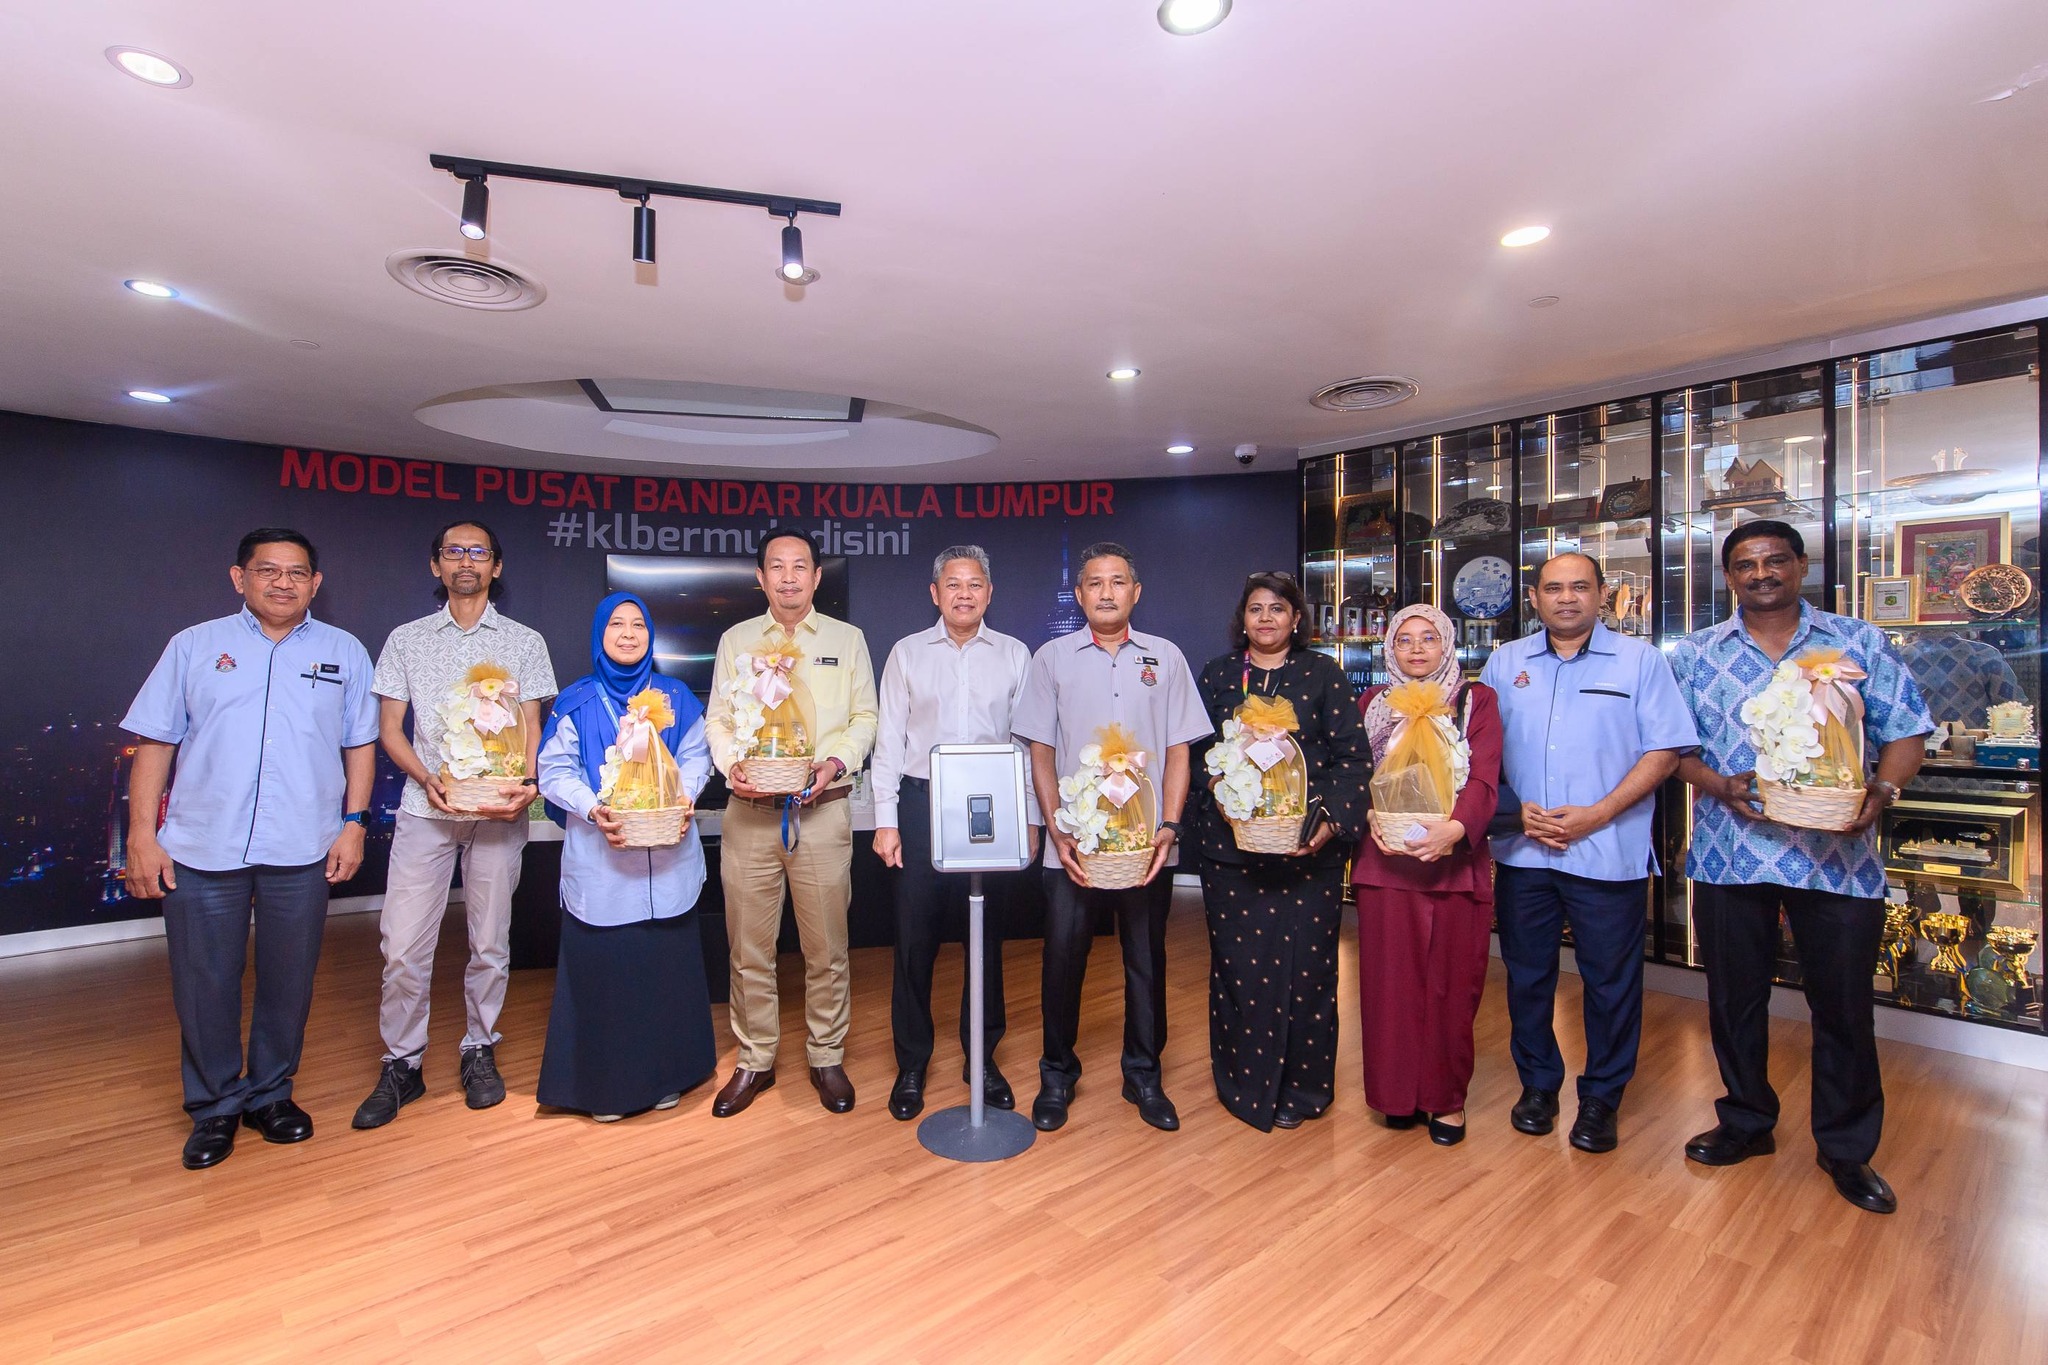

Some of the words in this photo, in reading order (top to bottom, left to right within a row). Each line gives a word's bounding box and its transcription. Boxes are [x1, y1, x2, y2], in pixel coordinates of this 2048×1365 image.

[280, 449, 460, 500] MODEL
[475, 467, 621, 509] PUSAT
[634, 478, 801, 516] BANDAR
[813, 484, 942, 518] KUALA
[955, 482, 1114, 518] LUMPUR
[547, 511, 910, 555] #klbermudisini
